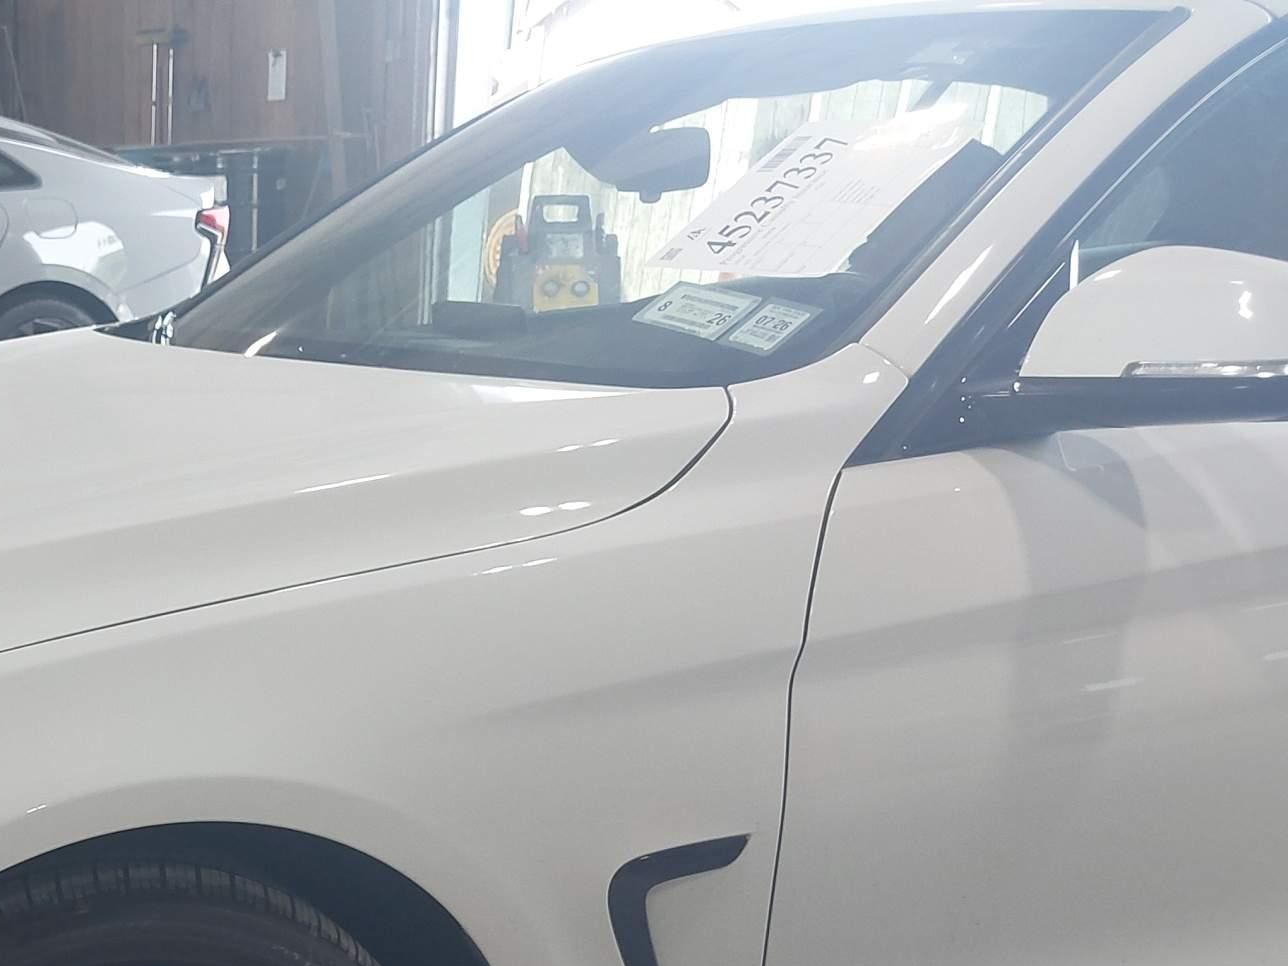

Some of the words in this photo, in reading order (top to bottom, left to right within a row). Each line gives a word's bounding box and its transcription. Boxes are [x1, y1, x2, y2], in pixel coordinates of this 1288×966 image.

[707, 137, 849, 254] 45237337
[657, 300, 673, 312] 8
[706, 312, 732, 326] 26
[774, 318, 793, 331] 26
